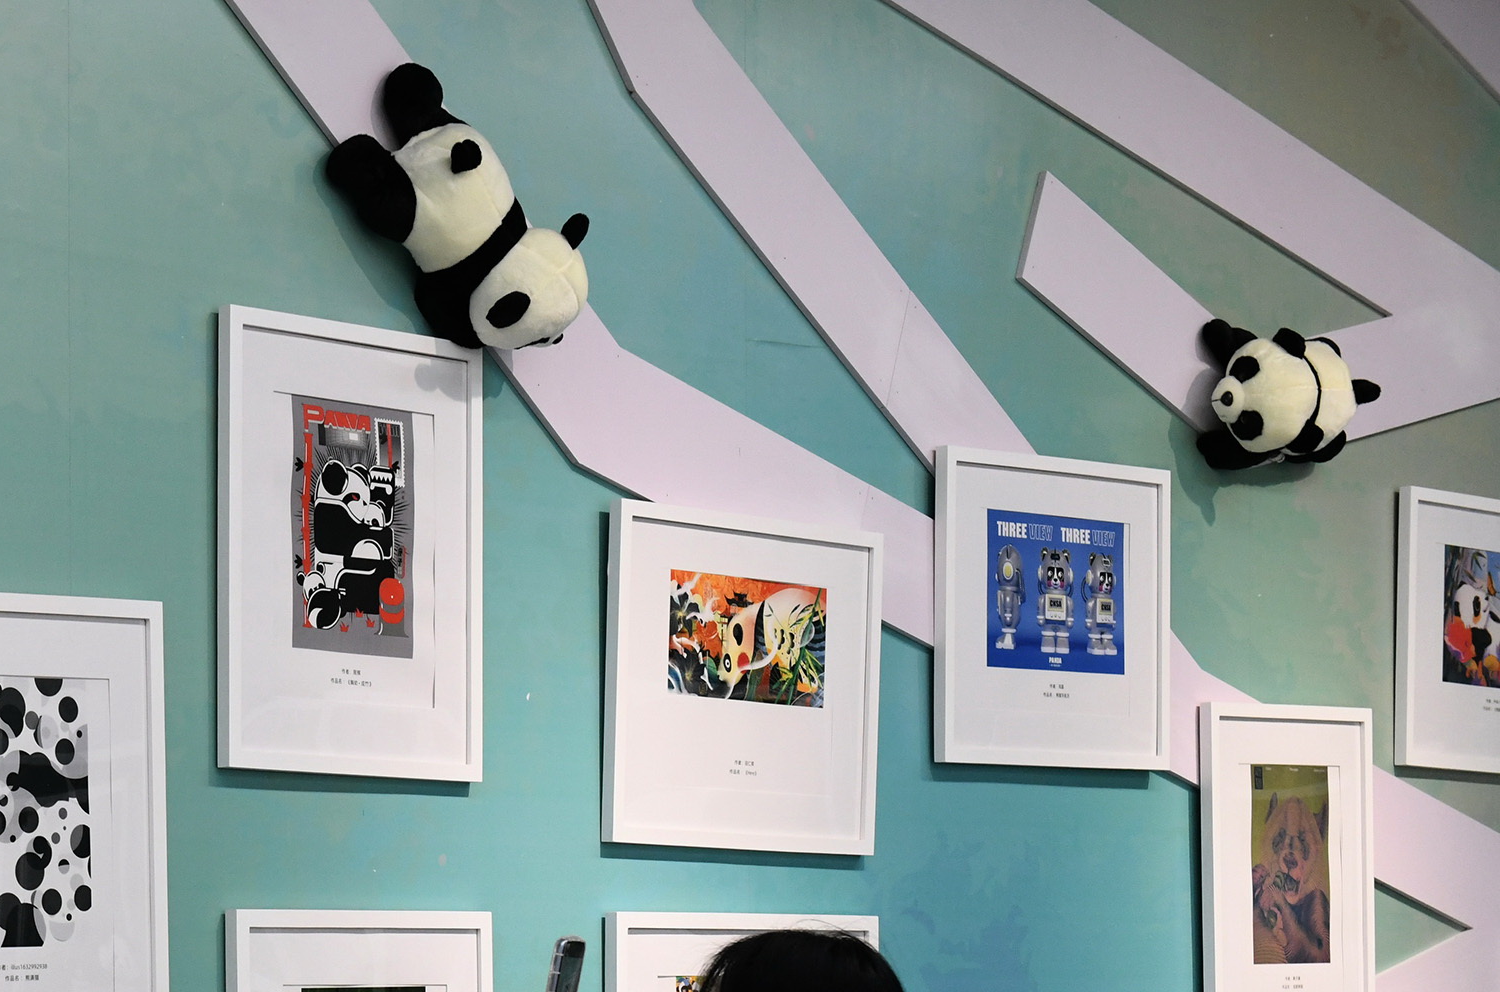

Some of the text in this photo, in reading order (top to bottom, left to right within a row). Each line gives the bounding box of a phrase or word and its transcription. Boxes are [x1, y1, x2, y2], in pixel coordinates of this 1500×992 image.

[996, 520, 1116, 548] THREE VIEW THREE VIEW
